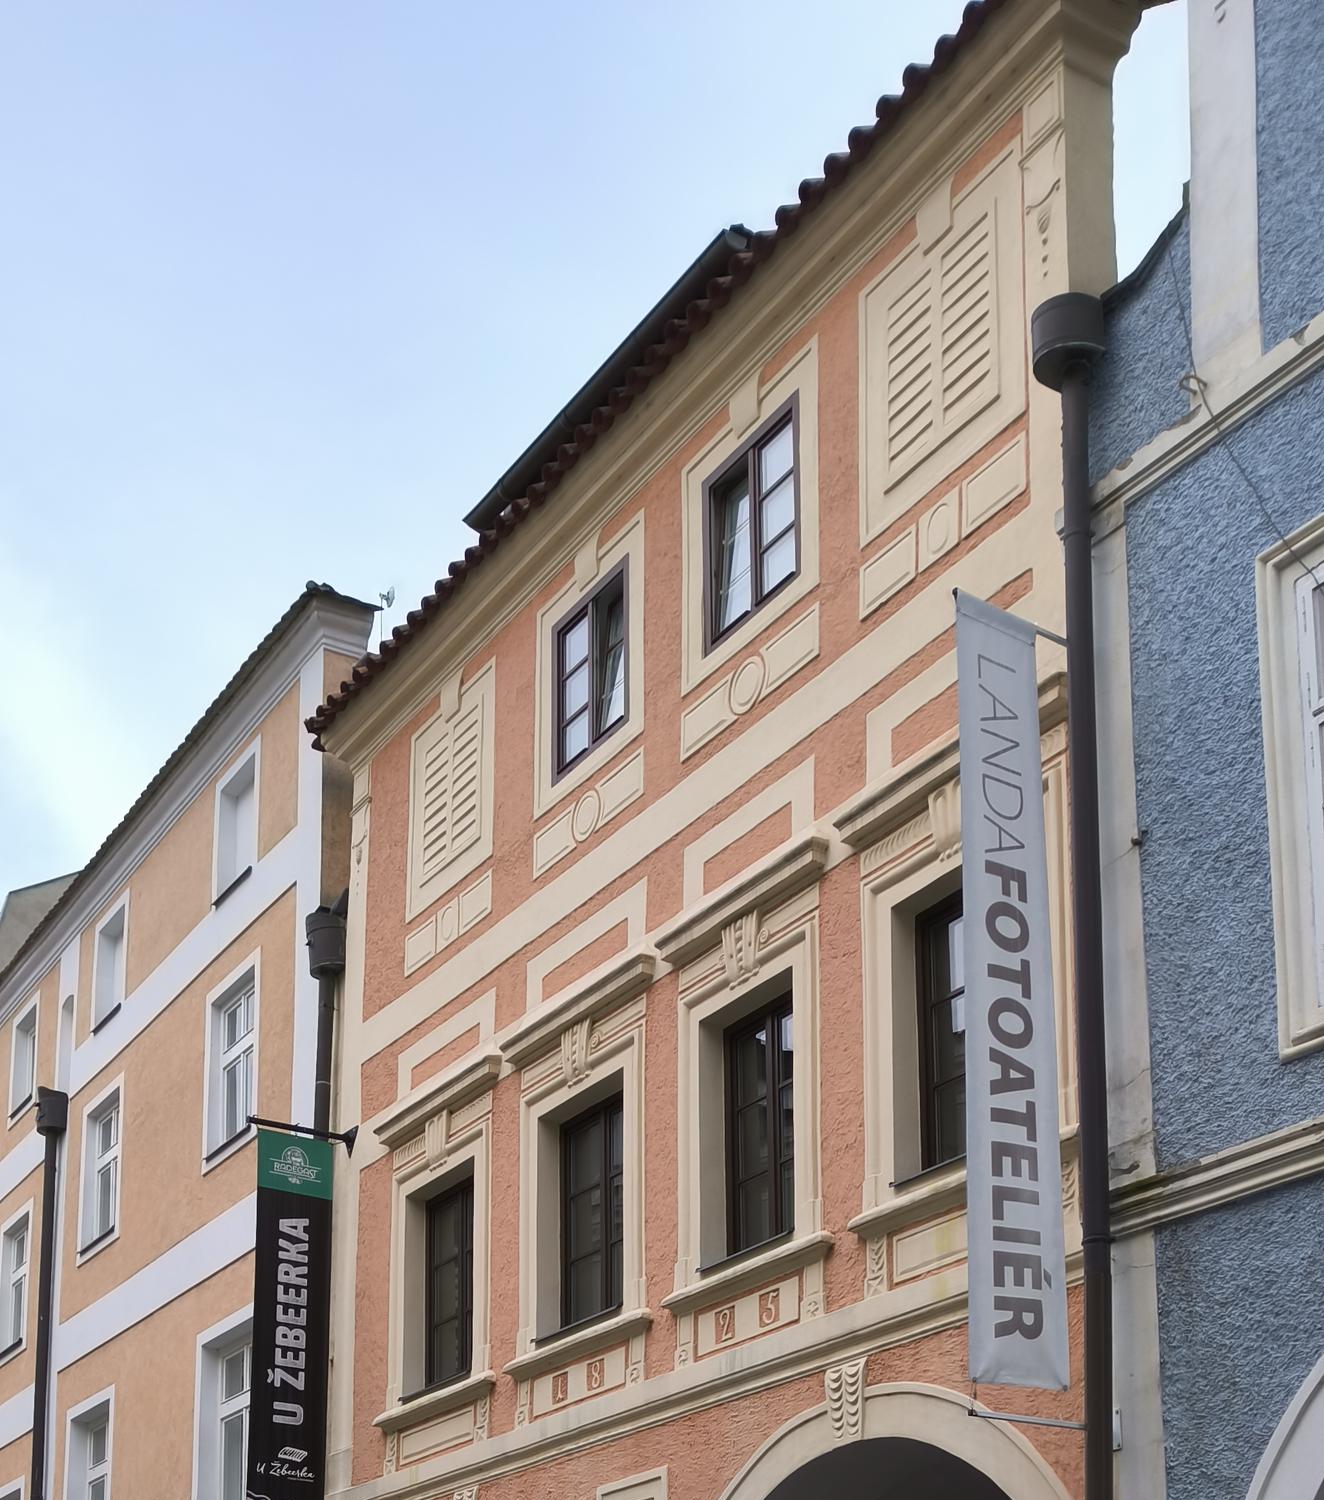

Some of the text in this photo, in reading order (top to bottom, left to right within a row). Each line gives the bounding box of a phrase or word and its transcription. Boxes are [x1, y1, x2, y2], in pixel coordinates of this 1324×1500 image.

[273, 1161, 319, 1179] RADEGAST
[266, 1217, 310, 1426] U ŽEBEERKA
[256, 1460, 316, 1479] U Žebeerka
